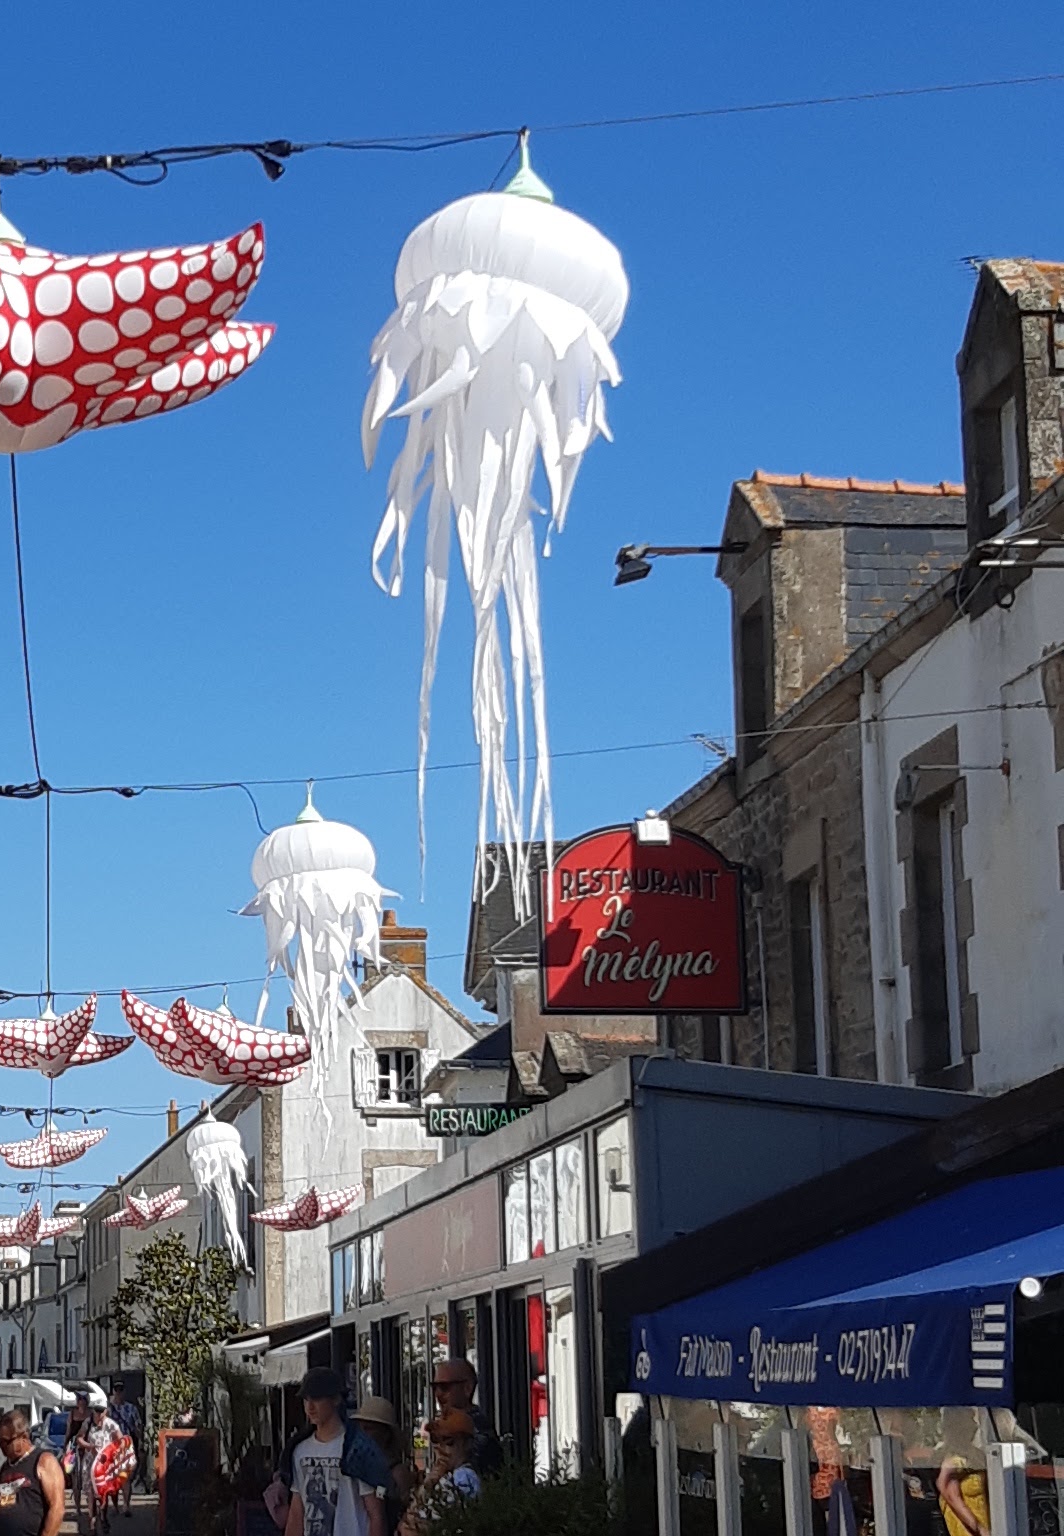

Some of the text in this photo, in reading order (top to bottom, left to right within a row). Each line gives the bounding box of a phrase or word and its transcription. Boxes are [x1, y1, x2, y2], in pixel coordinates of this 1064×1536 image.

[560, 867, 720, 903] RESTAURANT
[597, 896, 634, 943] Le
[582, 940, 719, 1002] Mélyna
[748, 1326, 819, 1393] Restaurant
